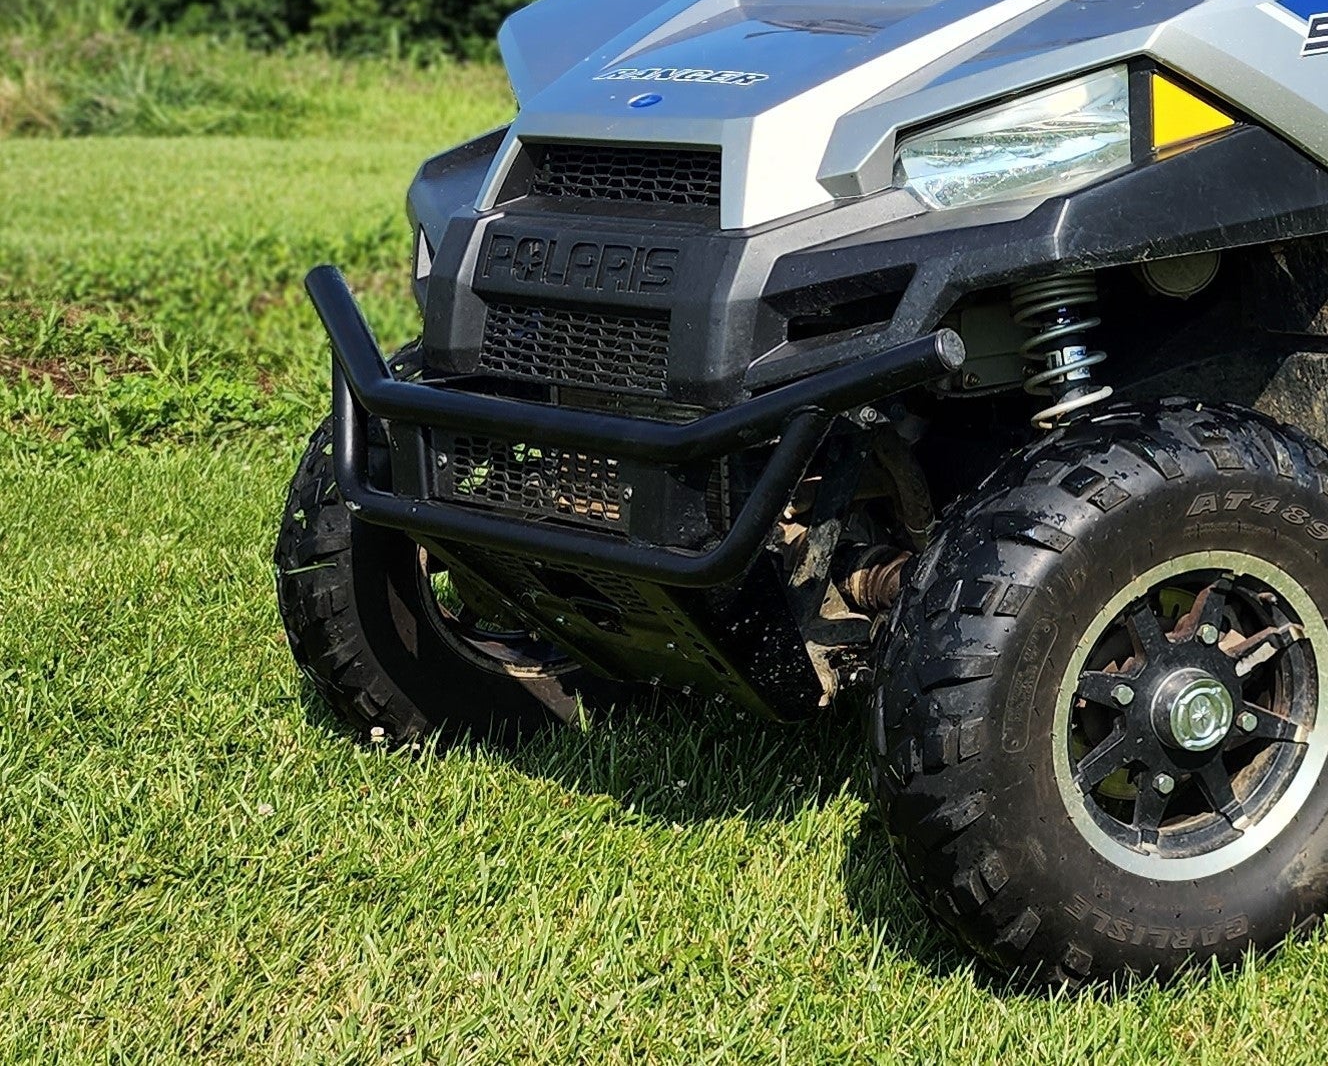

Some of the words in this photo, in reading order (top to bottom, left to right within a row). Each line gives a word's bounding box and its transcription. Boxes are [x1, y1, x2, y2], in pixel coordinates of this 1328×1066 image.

[592, 68, 770, 86] RANGER
[482, 234, 681, 295] POLARIS
[1063, 892, 1249, 949] CARLISLE
